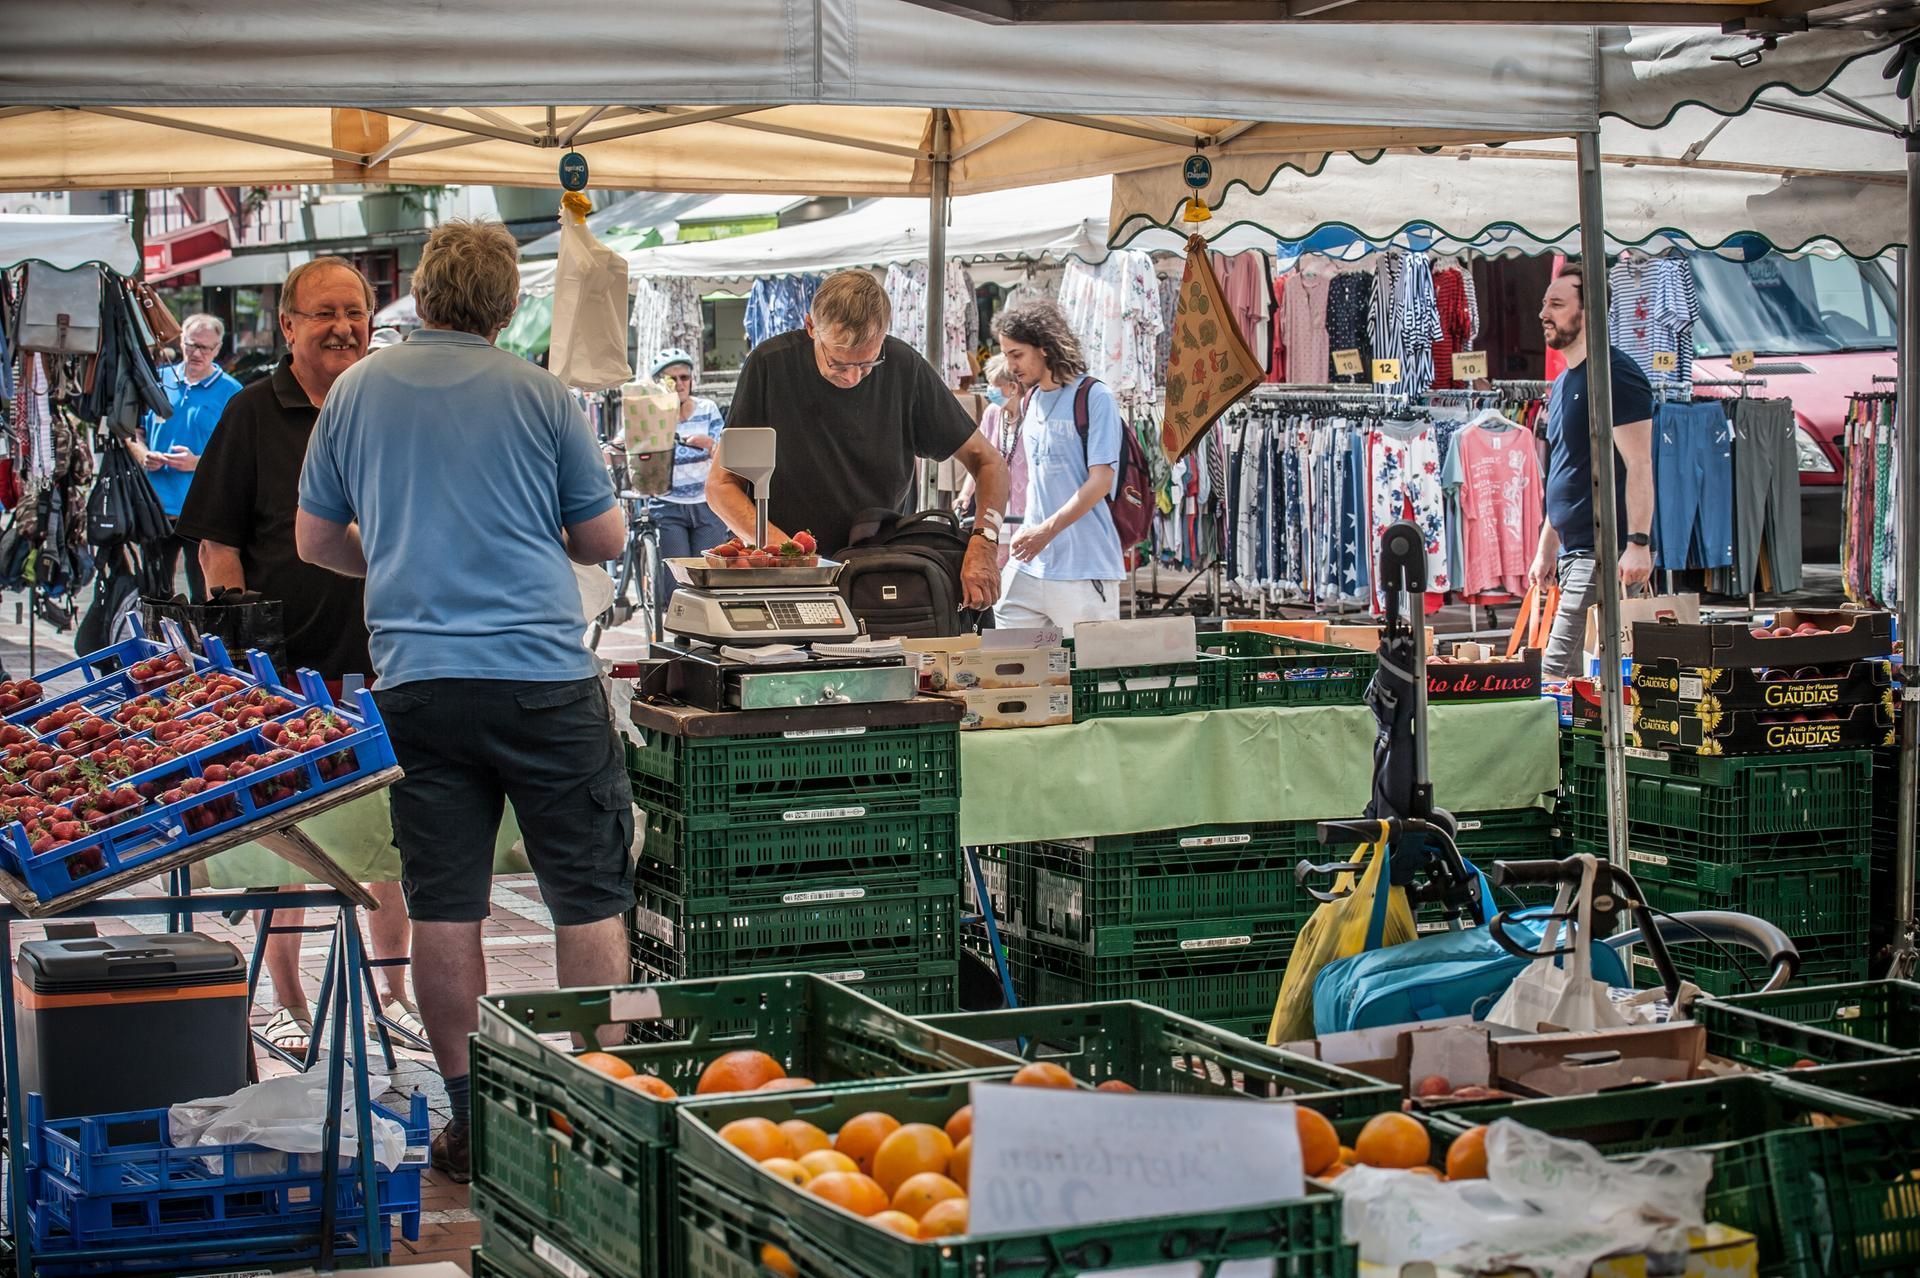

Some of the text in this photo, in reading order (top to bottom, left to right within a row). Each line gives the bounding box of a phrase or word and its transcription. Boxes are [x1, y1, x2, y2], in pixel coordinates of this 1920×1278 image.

[1453, 673, 1479, 692] de
[1481, 674, 1534, 691] Luxe
[1638, 675, 1669, 689] GAUDIAS
[1765, 685, 1839, 706] GAUDIAS
[1640, 717, 1670, 732] GAUDIAS
[1767, 726, 1840, 748] GAUDIAS
